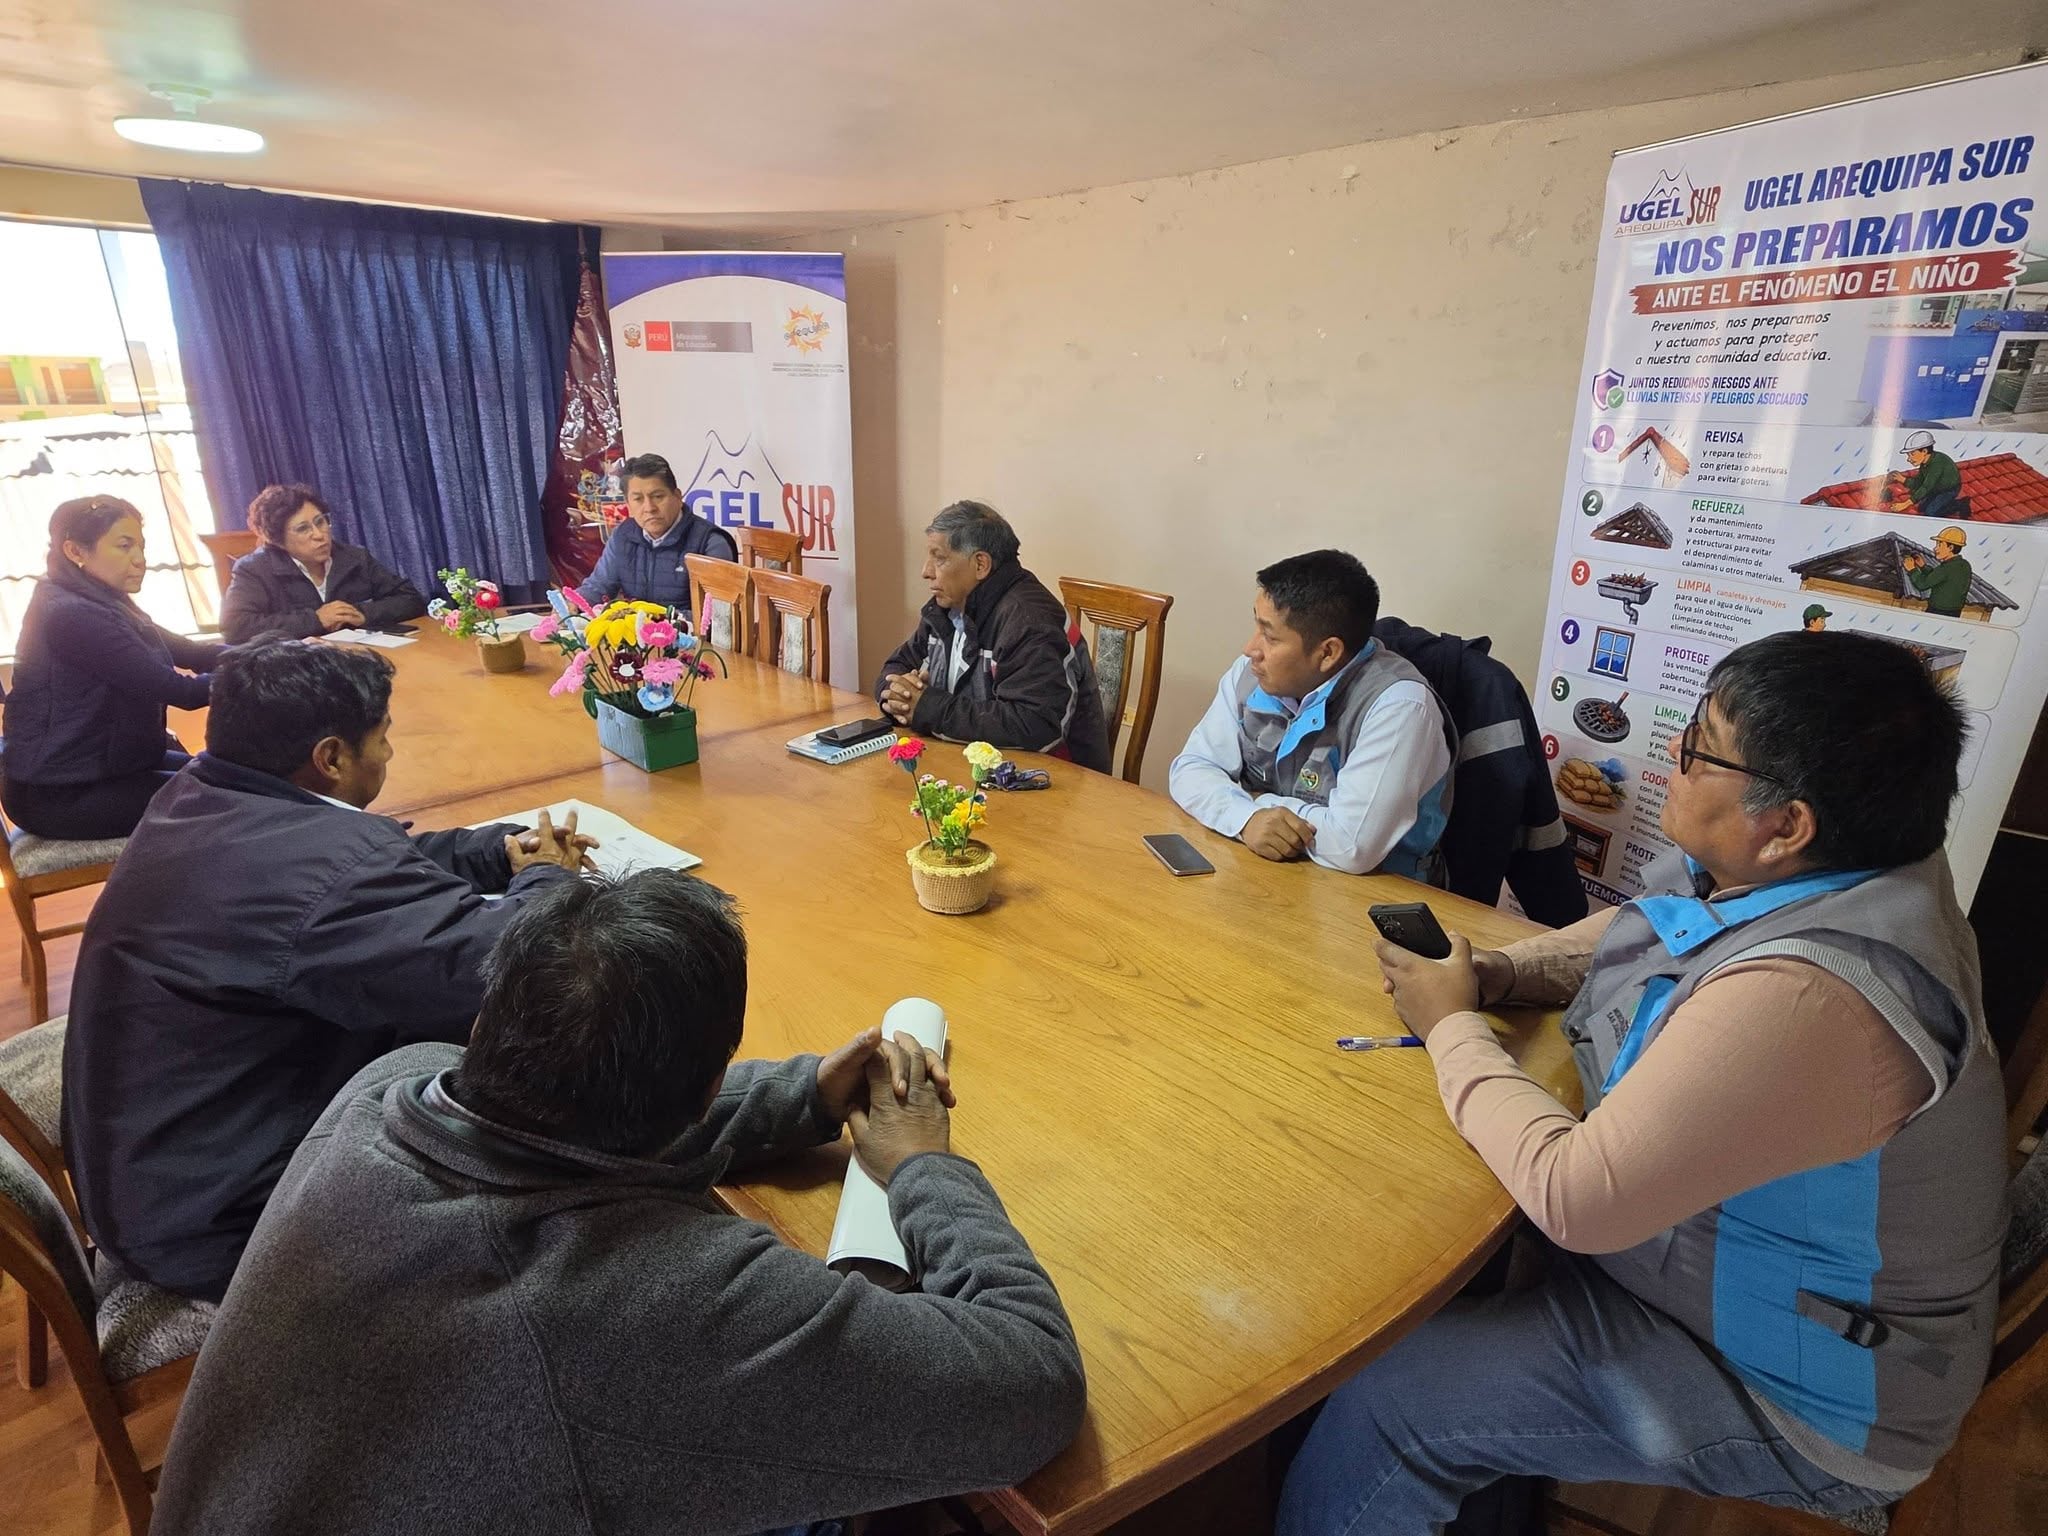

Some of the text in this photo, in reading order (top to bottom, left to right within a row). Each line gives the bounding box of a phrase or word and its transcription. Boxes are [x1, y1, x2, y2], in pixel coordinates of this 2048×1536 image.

[1743, 135, 2035, 212] UGEL AREQUIPA SUR
[1619, 186, 1721, 226] UGEL SUR
[1615, 219, 1683, 235] AREQUIPA
[1654, 198, 2034, 275] NOS PREPARAMOS
[1652, 256, 1980, 308] ANTE EL FENÓMENO EL NIÑO
[1651, 312, 1831, 332] Prevenimos, nos preparamos
[1654, 332, 1819, 351] y actuamos para proteger
[1635, 349, 1831, 366] a nuestra comunidad educativa.
[1628, 376, 1779, 389] JUNTOS REDUCIMOS RIESGOS ANTE
[1626, 391, 1809, 406] LLUVIAS INTENSAS Y PELIGROS ASOCIADOS
[1599, 430, 1607, 447] 1
[1704, 430, 1744, 444] REVISA
[1709, 450, 1735, 459] repara
[1737, 450, 1762, 460] techos
[1700, 461, 1714, 469] con
[1716, 462, 1743, 471] grietas
[1751, 464, 1788, 475] aberturas
[1697, 473, 1771, 487] para evitar goteras.
[1587, 494, 1597, 512] 2
[1691, 498, 1745, 515] REFUERZA
[684, 483, 836, 552] GEL SUR
[1690, 515, 1763, 530] y da mantenimiento
[1694, 526, 1736, 540] coberturas,
[1737, 533, 1775, 545] armazones
[1686, 538, 1772, 557] y estructuras para evitar
[1684, 548, 1763, 568] el desprendimiento de
[1575, 565, 1585, 582] 3
[1681, 559, 1718, 571] calaminas
[1725, 566, 1744, 576] otros
[1745, 570, 1785, 583] materiales.
[1677, 578, 1712, 593] LIMPIA
[1755, 596, 1787, 609] drenajes
[1675, 593, 1764, 615] para que el agua de lluvia
[1671, 613, 1734, 632] (Limpieza de techos
[1674, 602, 1753, 625] fluya sin obstrucciones.
[1565, 624, 1575, 641] 4
[1670, 623, 1707, 635] eliminando
[1665, 646, 1710, 666] PROTEGE
[1663, 659, 1706, 677] las ventanas
[1661, 671, 1699, 687] coberturas
[1555, 680, 1565, 697] 5
[1659, 683, 1676, 692] para
[1677, 687, 1697, 698] evitar
[1654, 705, 1688, 724] LIMPIA
[1653, 720, 1683, 733] sumider
[1545, 740, 1554, 754] 6
[1647, 751, 1656, 759] de
[1642, 770, 1669, 788] COOR
[1640, 785, 1652, 794] con
[1653, 788, 1663, 798] las
[1636, 826, 1676, 848] inundacione
[1625, 842, 1658, 862] PROTE
